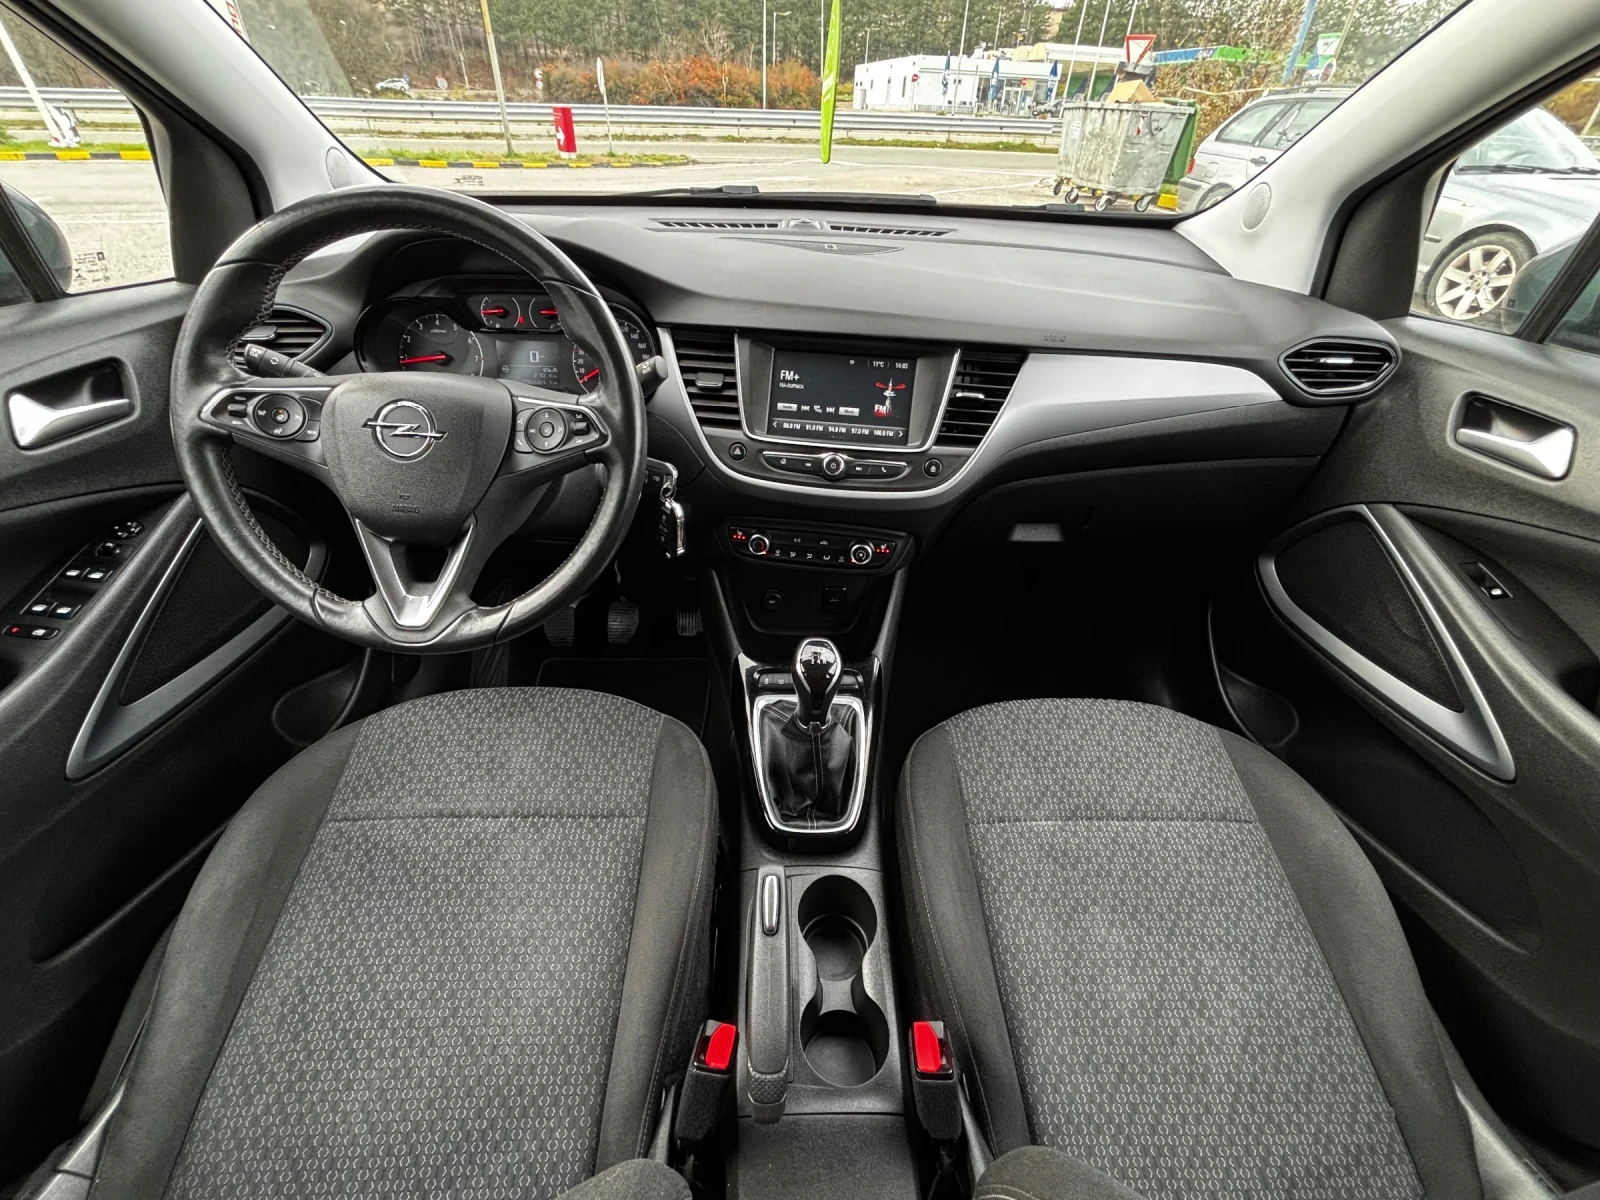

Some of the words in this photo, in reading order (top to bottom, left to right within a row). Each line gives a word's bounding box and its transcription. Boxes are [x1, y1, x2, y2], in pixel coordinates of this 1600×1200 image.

[453, 323, 458, 331] 5
[406, 335, 411, 343] 2
[780, 369, 800, 381] FM+
[874, 404, 887, 415] FM
